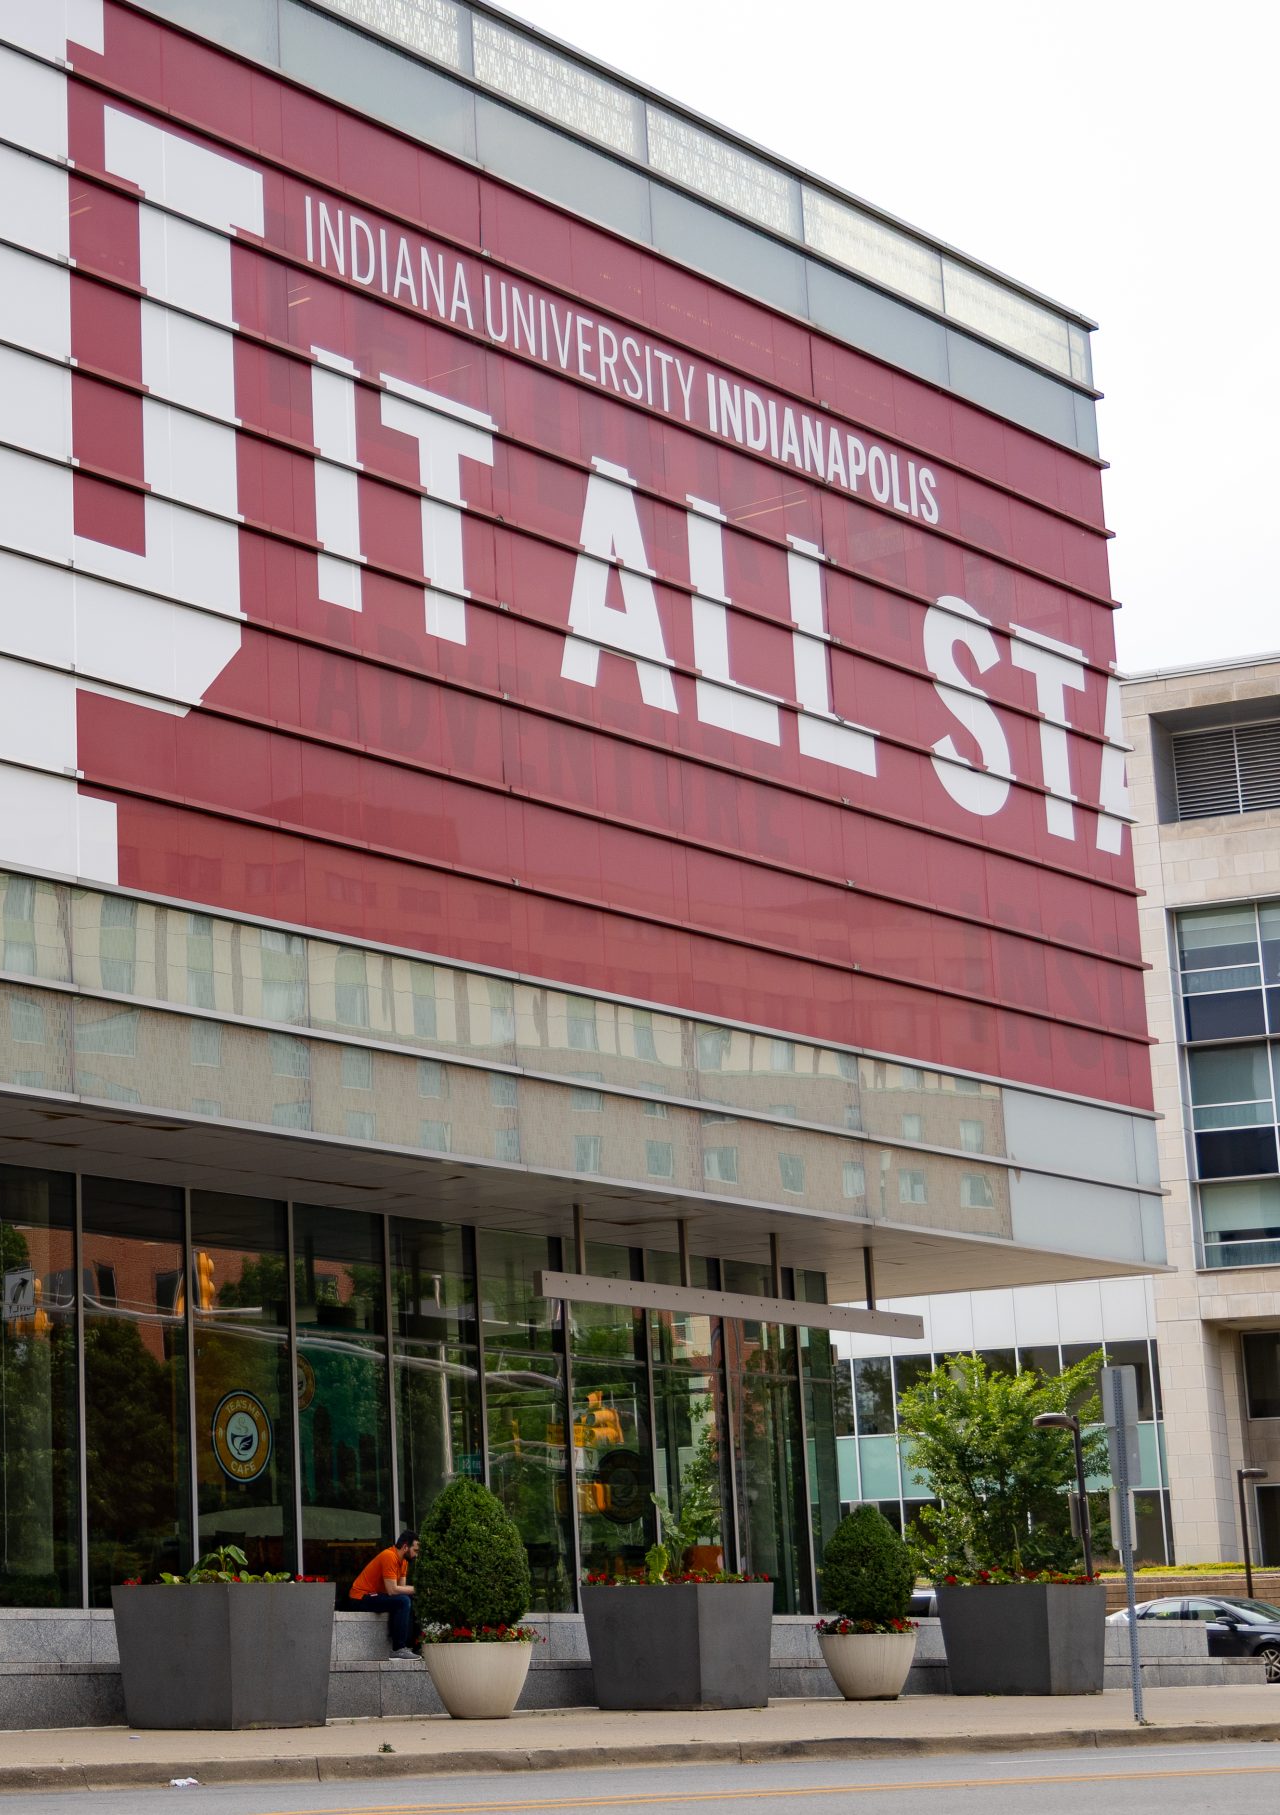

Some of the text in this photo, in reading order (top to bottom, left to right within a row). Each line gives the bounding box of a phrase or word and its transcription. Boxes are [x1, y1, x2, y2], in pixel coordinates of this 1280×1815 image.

[305, 195, 939, 525] INDIANA UNIVERSITY INDIANAPOLIS
[310, 345, 498, 646] IT
[560, 456, 878, 778] ALL
[247, 1405, 262, 1419] ME
